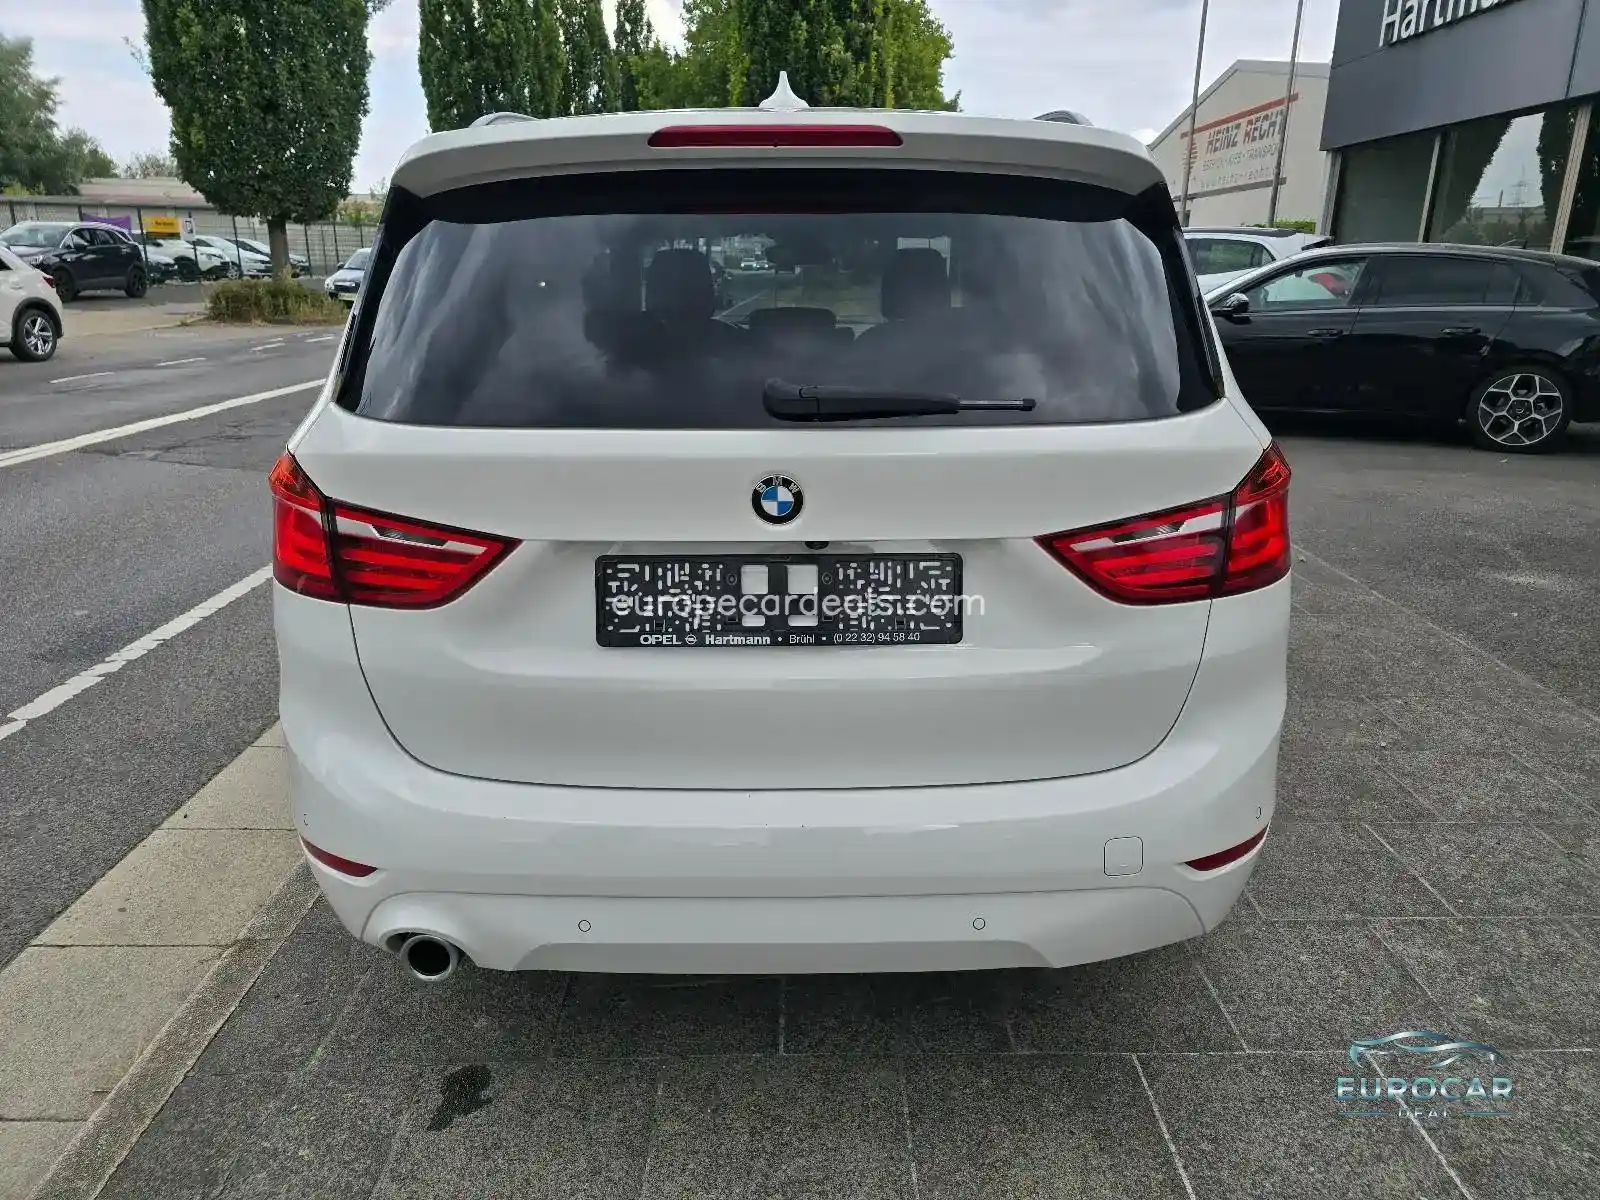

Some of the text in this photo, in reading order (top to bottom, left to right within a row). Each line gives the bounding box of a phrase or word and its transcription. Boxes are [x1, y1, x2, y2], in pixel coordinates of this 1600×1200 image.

[1379, 0, 1501, 47] Hartm
[1206, 122, 1241, 155] HEINZ
[756, 476, 800, 493] BMW
[639, 632, 920, 645] OPEL Hartmann Brühl (0 22 32) 94 58 40
